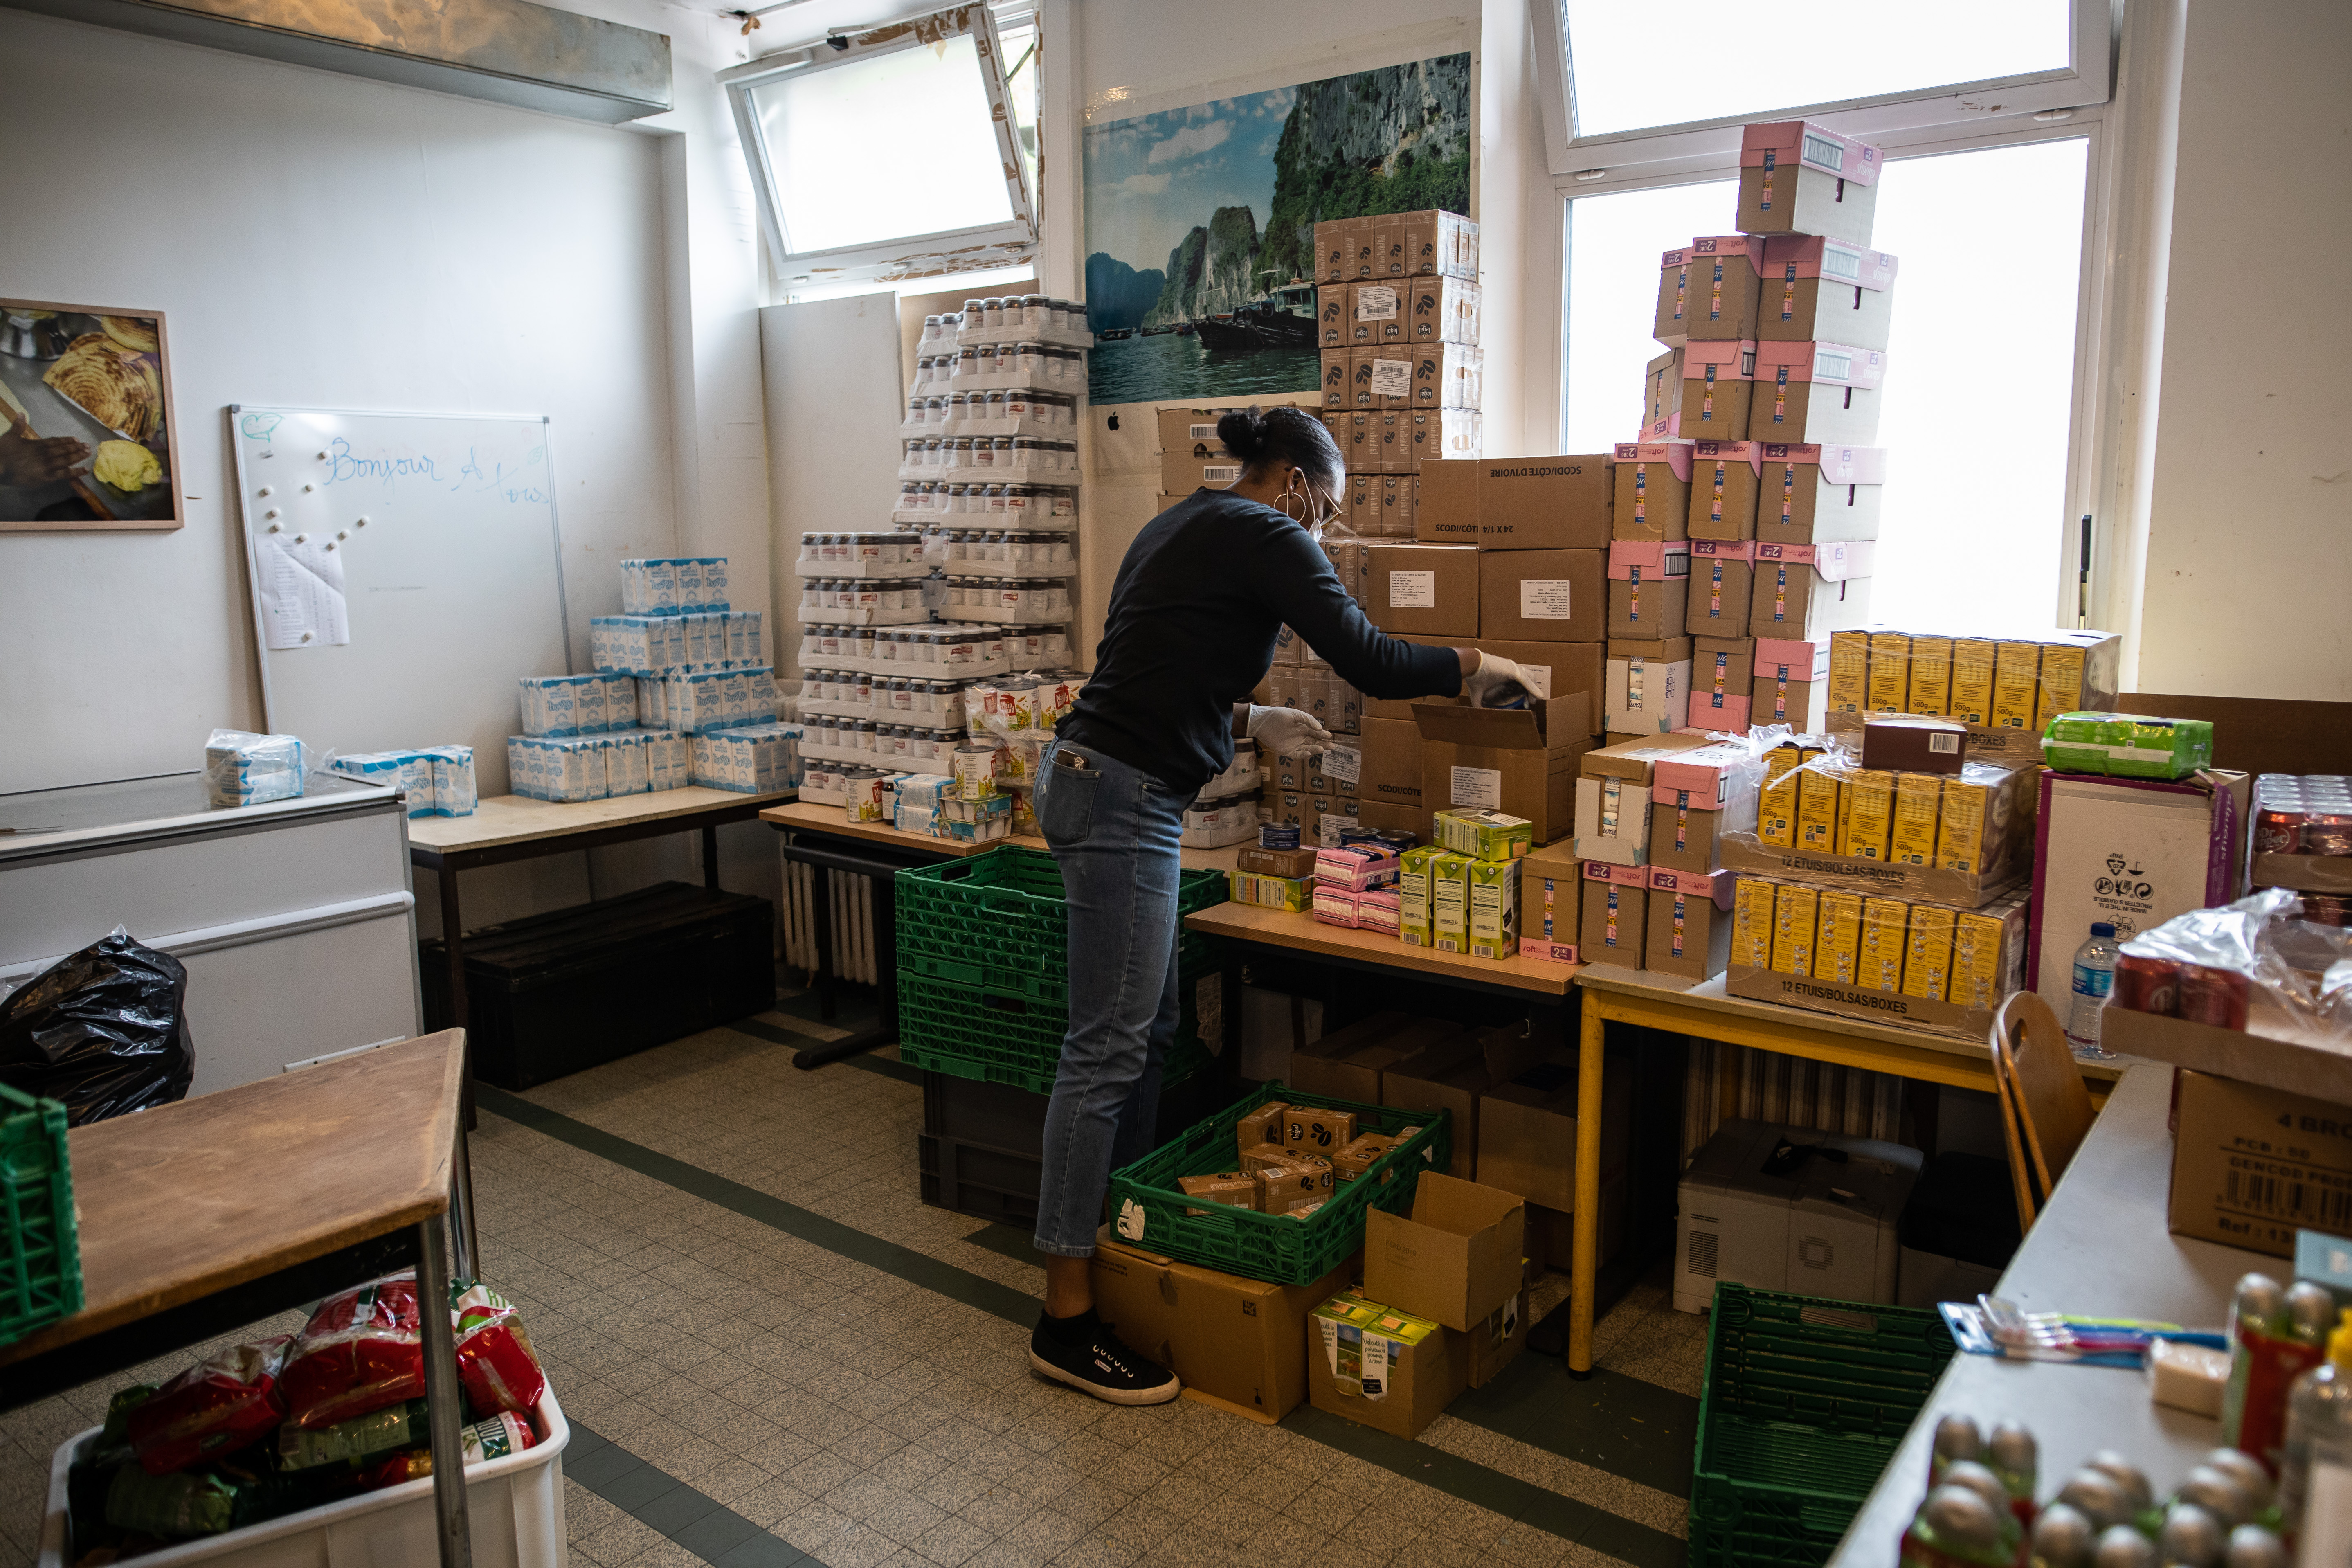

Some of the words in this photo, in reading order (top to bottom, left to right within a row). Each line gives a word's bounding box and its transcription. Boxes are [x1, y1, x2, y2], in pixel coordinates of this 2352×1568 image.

[1857, 161, 1875, 182] always
[1707, 241, 1713, 251] 2
[1675, 253, 1680, 262] 2
[1656, 425, 1660, 434] 2
[1629, 448, 1635, 457] 2
[1710, 445, 1716, 454] 2
[1779, 446, 1785, 456] 2
[323, 437, 445, 497] Bonjour
[1529, 466, 1581, 477] SCODI/CÔTE
[1490, 468, 1527, 477] D'IVOIRE
[1707, 544, 1713, 553] 2
[1773, 546, 1780, 556] 2
[1001, 701, 1013, 710] Main
[1872, 697, 1887, 706] 500g
[1913, 701, 1928, 710] 500g
[1954, 704, 1970, 713] 500g
[1997, 708, 2013, 717] 500g
[1378, 784, 1422, 796] SCODI/CÔTE
[1762, 810, 1777, 818] 500g
[1802, 815, 1817, 823] 500g
[2220, 793, 2232, 861] always
[2261, 828, 2276, 837] Dr
[1850, 837, 1867, 846] 500g
[1896, 843, 1913, 852] 500g
[1942, 850, 1960, 858] 500g
[1601, 866, 1608, 877] 2
[1781, 855, 1792, 866] 12
[1794, 857, 1905, 882] ETUIS/BOLSAS/BOXES
[1626, 872, 1641, 880] soft
[1667, 876, 1674, 886] 2
[1695, 881, 1709, 890] soft
[2125, 900, 2153, 909] PROCTER
[1554, 948, 1560, 958] 2
[1782, 980, 1792, 992] 12
[1795, 983, 1907, 1014] ETUIS/BOLSAS/BOXES
[2235, 1136, 2271, 1152] PCB
[2219, 1217, 2251, 1235] Ref
[1386, 1240, 1401, 1251] FEAD
[1402, 1246, 1417, 1256] 2019
[1363, 1338, 1380, 1346] Velouté
